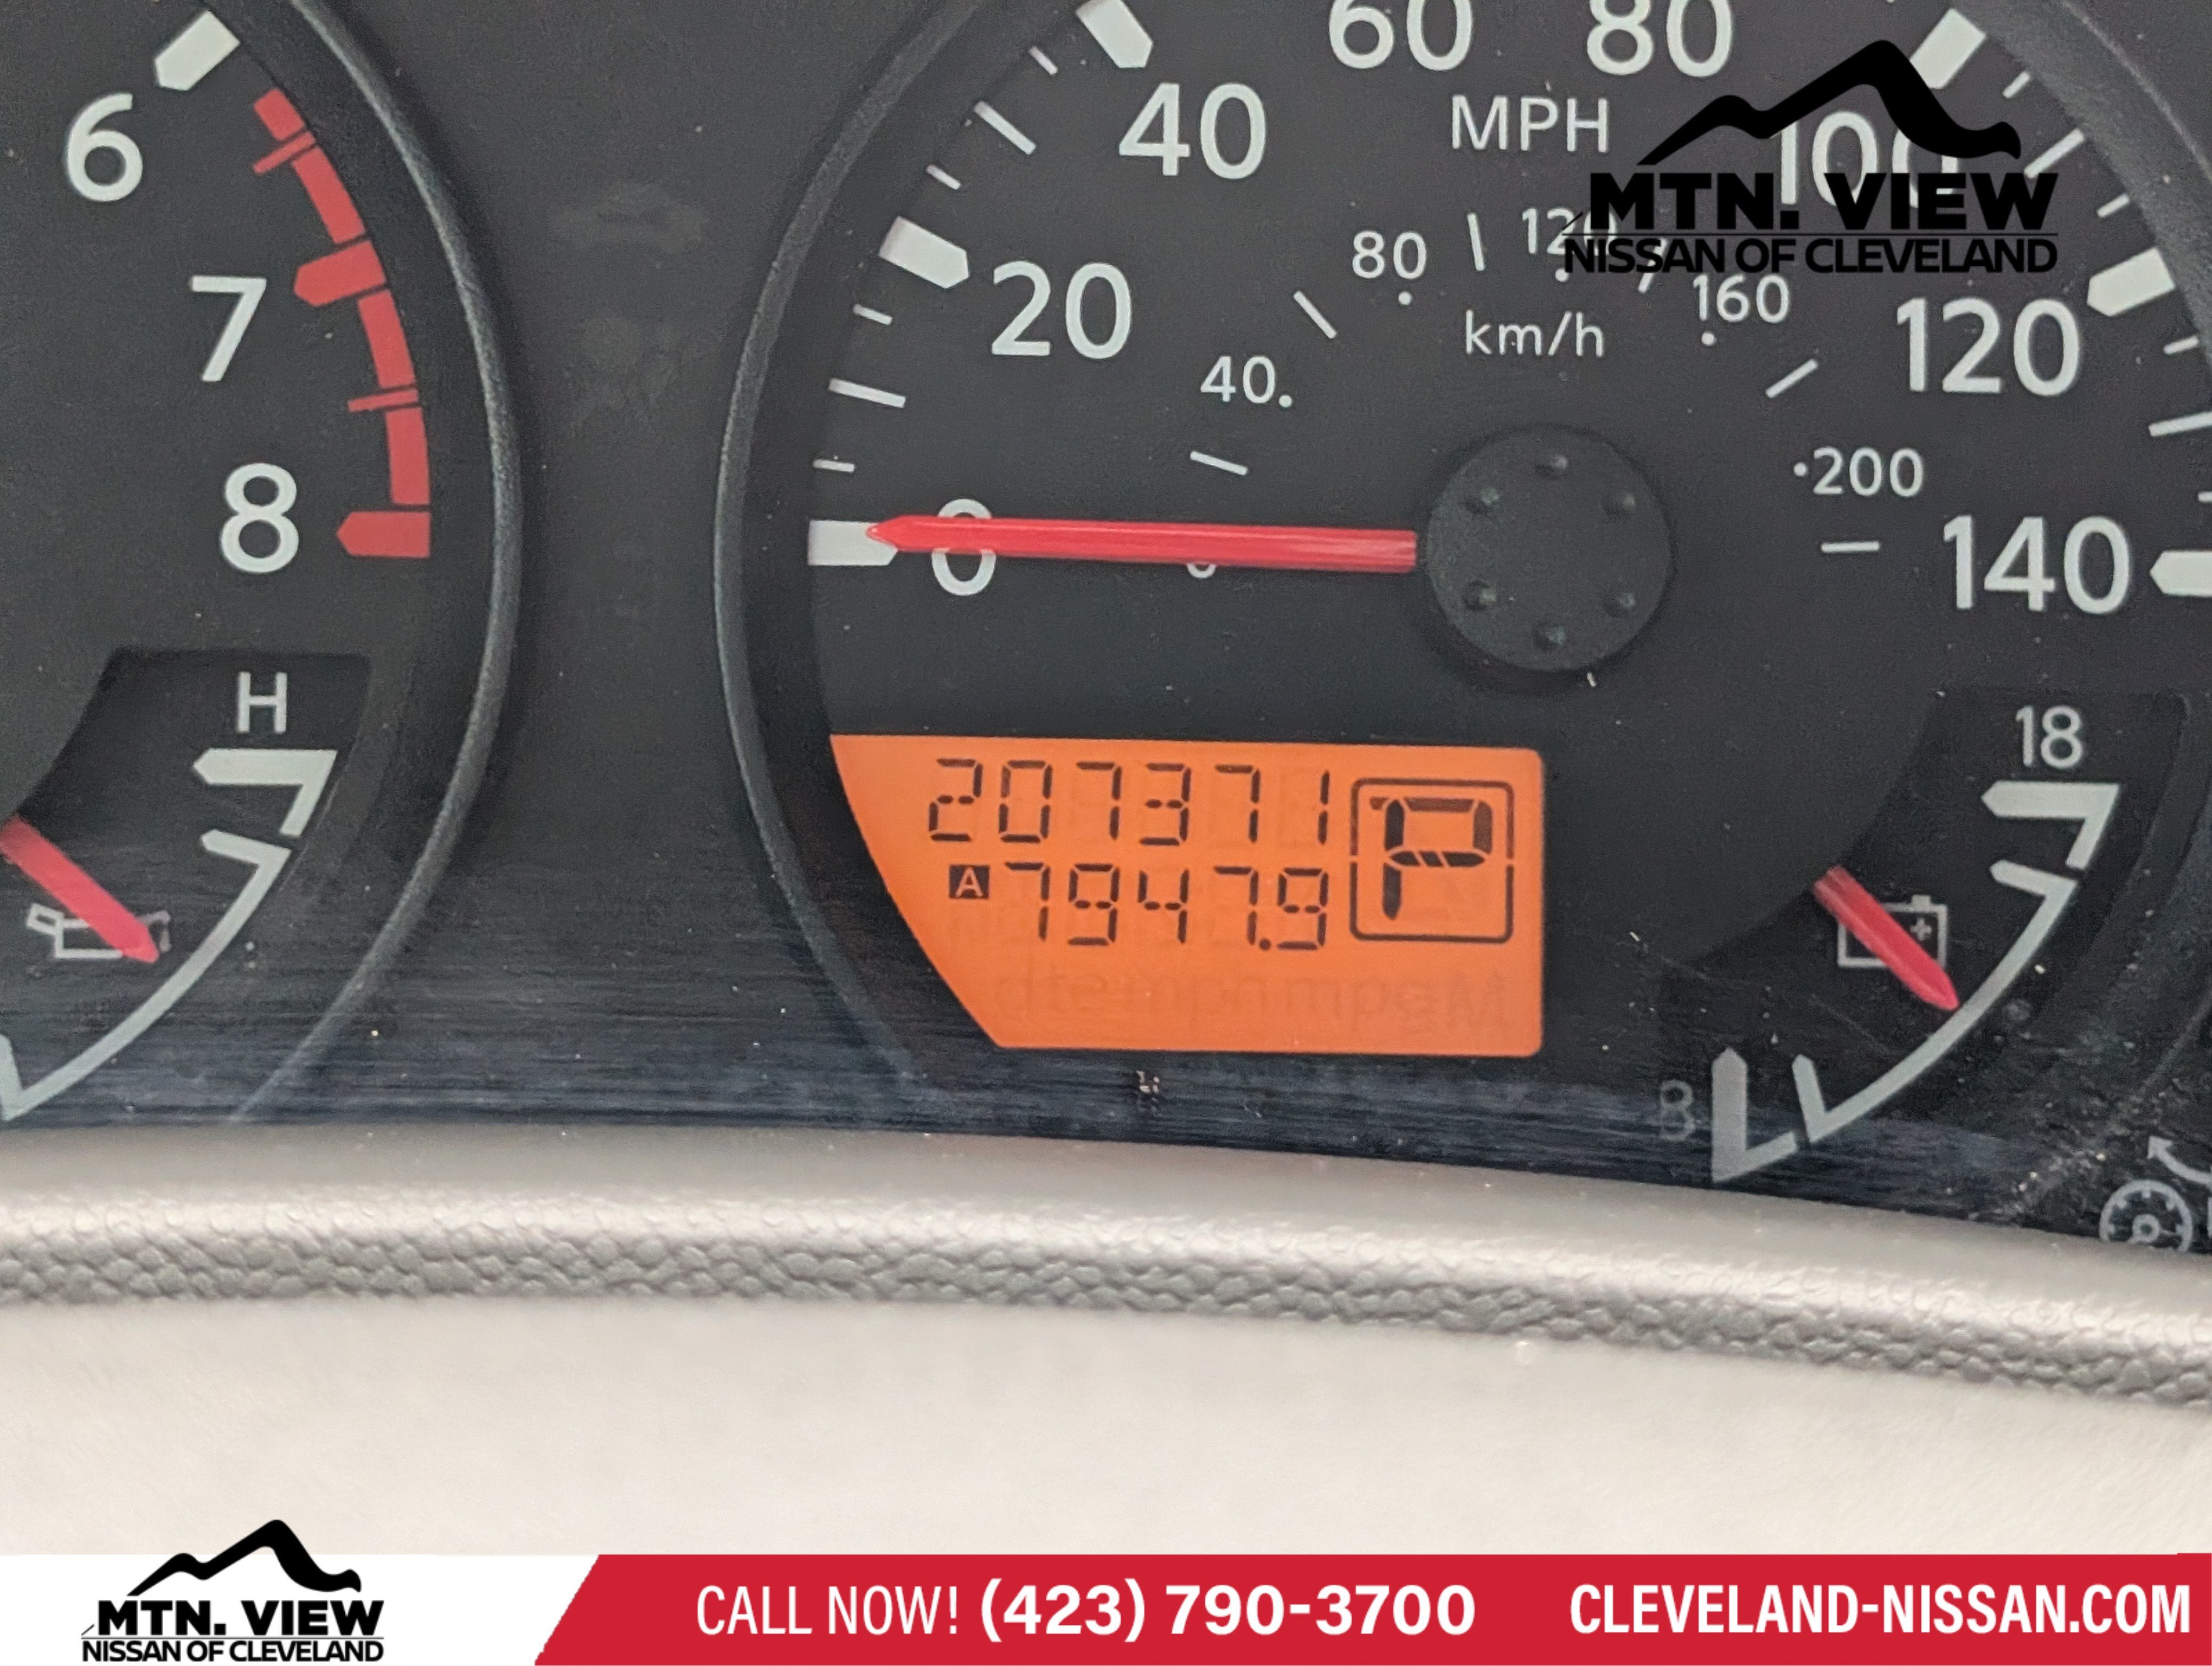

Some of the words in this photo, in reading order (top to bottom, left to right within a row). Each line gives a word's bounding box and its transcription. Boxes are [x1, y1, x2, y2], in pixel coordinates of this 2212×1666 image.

[1328, 0, 1474, 71] 60
[1586, 0, 1733, 78] 80
[67, 93, 143, 202] 6
[1118, 82, 1267, 180] 40
[1452, 95, 1608, 152] MPH
[1352, 230, 1427, 279] 80
[1693, 274, 1790, 323] 160
[191, 275, 267, 382] 7
[991, 260, 1132, 359] 20
[1465, 310, 1604, 357] km/h
[1897, 297, 2081, 396] 120
[1814, 447, 1924, 497] 200
[220, 463, 299, 573] 8
[931, 498, 996, 596] 0
[1944, 515, 2131, 614] 140
[237, 672, 287, 733] H
[2016, 706, 2084, 768] 18
[928, 758, 1330, 847] 207371
[1370, 797, 1493, 920] P
[955, 868, 986, 897] A
[1005, 862, 1329, 951] 7947.9
